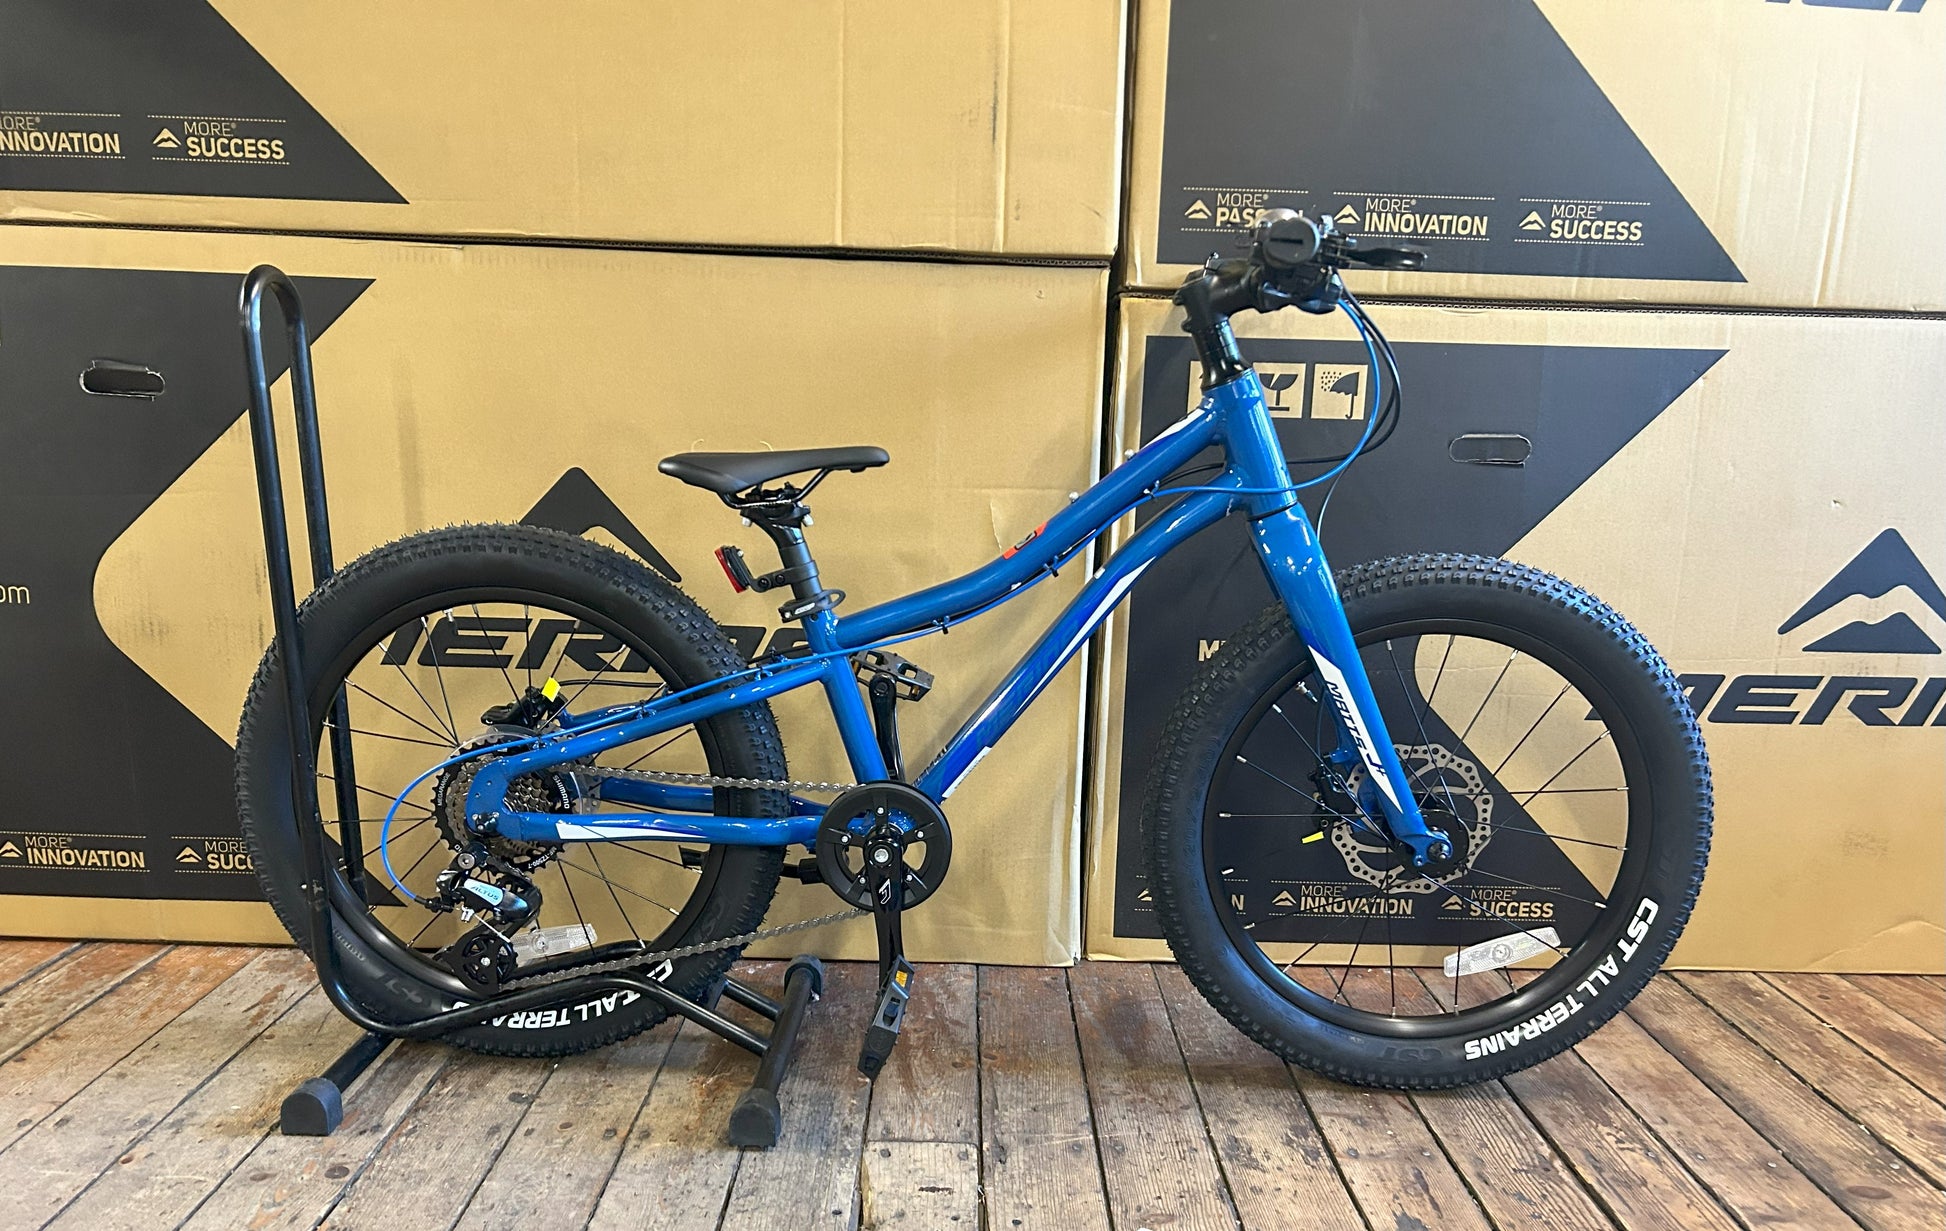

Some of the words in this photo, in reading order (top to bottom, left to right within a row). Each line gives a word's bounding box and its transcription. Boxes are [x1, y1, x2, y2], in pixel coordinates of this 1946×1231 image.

[0, 131, 121, 154] NNOVATION
[186, 137, 286, 159] SUCCESS
[1364, 212, 1489, 236] INNOVATION
[1550, 219, 1643, 241] SUCCESS
[553, 774, 571, 809] SHIMANO
[27, 847, 146, 868] INNOVATION
[470, 886, 499, 901] ALTUS
[1301, 896, 1413, 915] INNOVATION
[1469, 901, 1554, 918] SUCCESS
[1616, 897, 1659, 963] CST
[1576, 953, 1620, 997] ALL
[575, 993, 617, 1021] ALL
[1464, 992, 1584, 1060] TERRAINS
